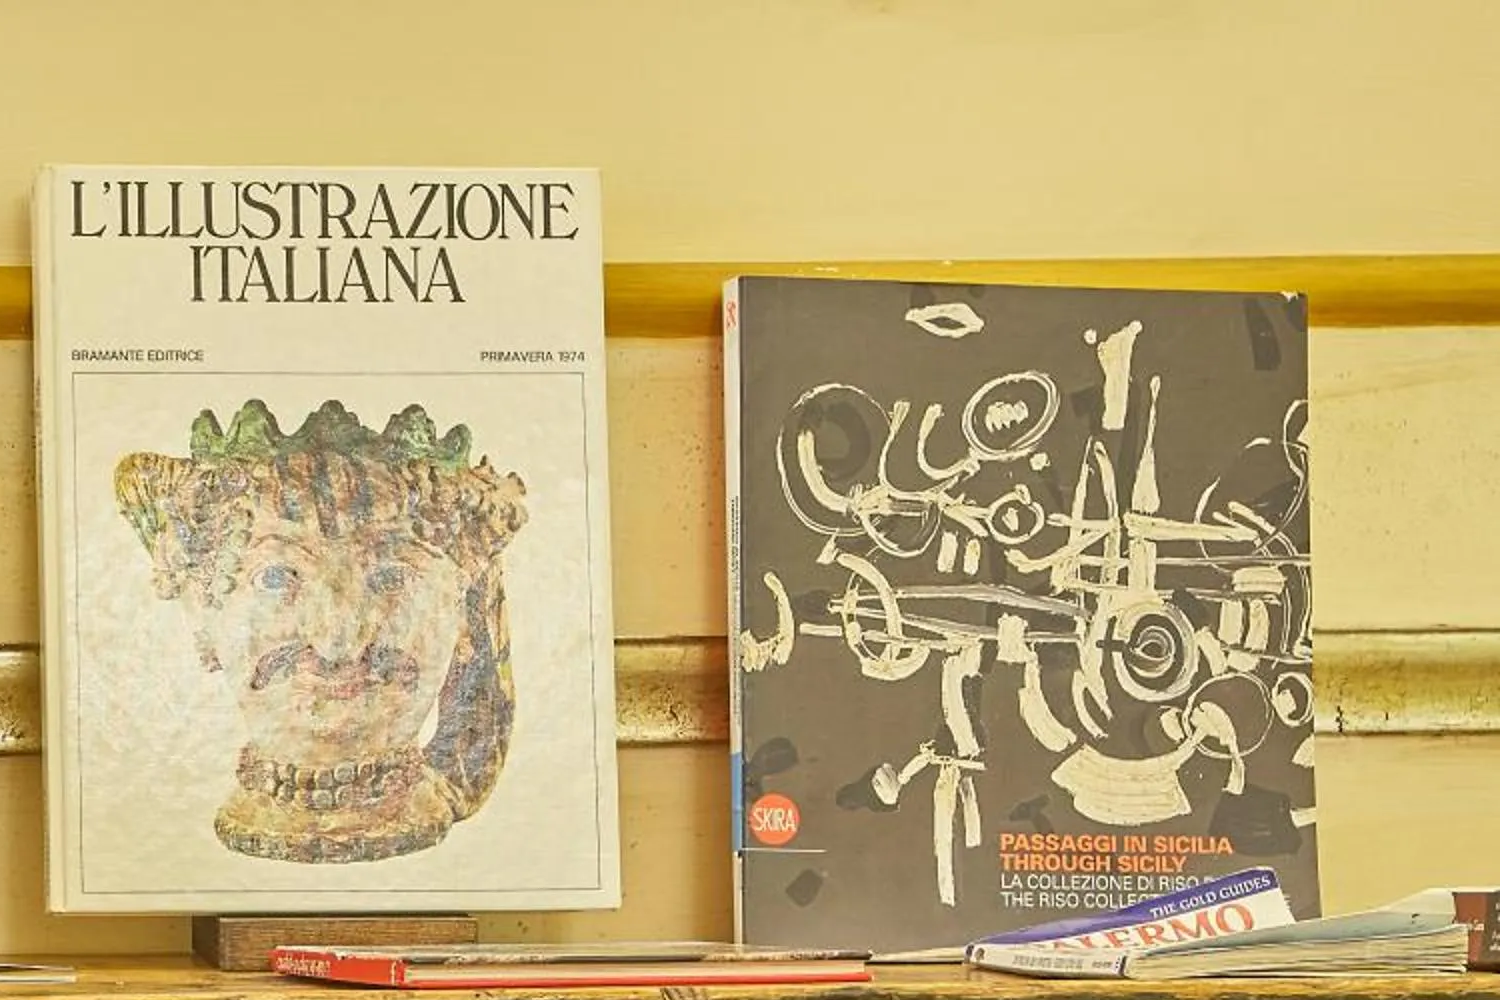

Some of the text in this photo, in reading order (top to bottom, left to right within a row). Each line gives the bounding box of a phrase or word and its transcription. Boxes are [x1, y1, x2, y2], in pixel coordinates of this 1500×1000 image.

[71, 181, 579, 240] L'ILLUSTRAZIONE
[190, 246, 466, 302] ITALIANA
[71, 349, 204, 361] BRAMANTE EDITRICE
[480, 351, 585, 362] PRIMAVERA 1974
[753, 807, 797, 832] SKIRA
[1000, 834, 1234, 855] PASSAGGI IN SICILIA
[1000, 854, 1188, 874] THROUGH SICILY
[1001, 874, 1023, 890] LA
[1027, 875, 1134, 892] COLLEZIONE
[1137, 876, 1155, 892] DI
[1159, 876, 1200, 892] RISO
[1001, 892, 1034, 908] THE
[1038, 892, 1080, 909] RISO
[1150, 901, 1179, 919] THE
[1179, 891, 1218, 911] GOLD
[1219, 875, 1272, 900] GUIDES
